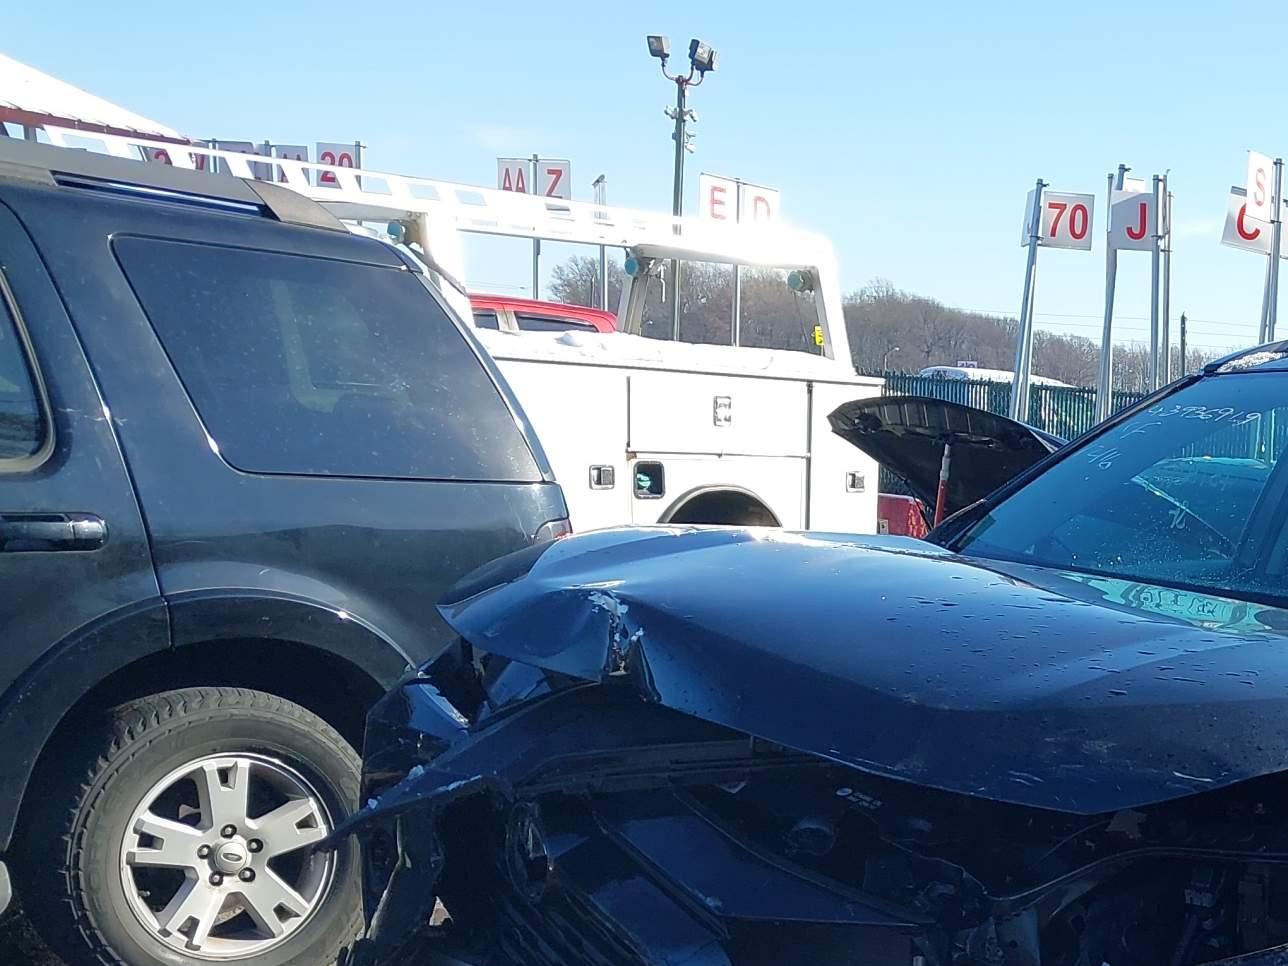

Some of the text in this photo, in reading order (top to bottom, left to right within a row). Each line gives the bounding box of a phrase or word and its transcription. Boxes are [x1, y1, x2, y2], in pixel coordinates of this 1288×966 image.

[502, 167, 526, 193] AA
[545, 169, 563, 199] Z
[1254, 167, 1267, 207] S
[711, 185, 727, 221] E
[1047, 202, 1089, 240] 70
[1126, 203, 1147, 240] J
